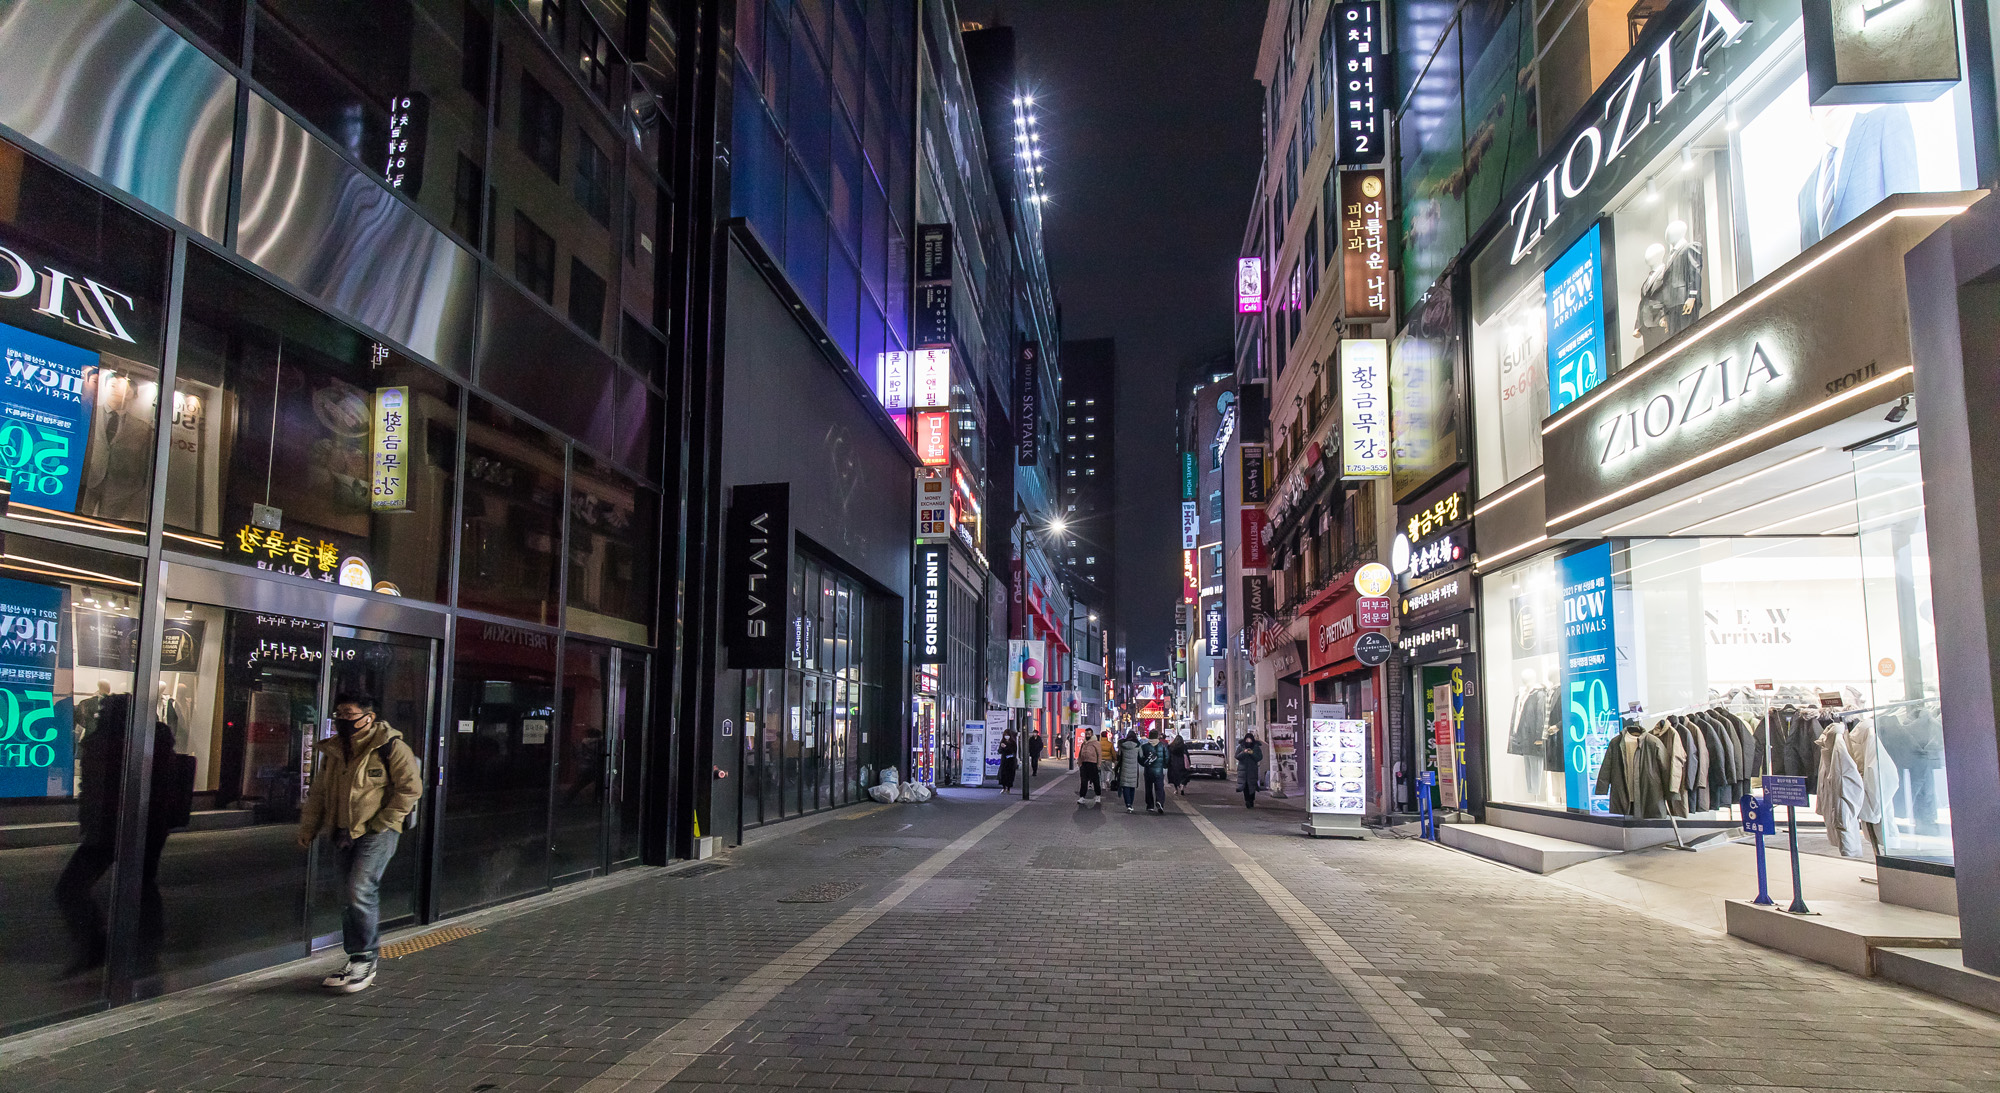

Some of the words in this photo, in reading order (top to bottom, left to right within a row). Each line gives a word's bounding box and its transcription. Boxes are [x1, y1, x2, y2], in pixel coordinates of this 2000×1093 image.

[1347, 6, 1374, 133] 이철헤어커커
[1356, 135, 1368, 152] 2
[1510, 0, 1753, 265] ZIOZIA
[1347, 202, 1364, 252] 피부과
[1365, 201, 1384, 269] 아름다운
[1368, 276, 1385, 310] 나라
[1553, 267, 1593, 319] new
[1554, 290, 1593, 329] ARRIVALS
[1503, 336, 1532, 374] SUIT
[1825, 361, 1880, 397] SEOUL
[1352, 366, 1377, 459] 황금목장
[1600, 341, 1783, 466] ZIOZIA
[1023, 395, 1033, 459] SKYPARK
[1408, 492, 1460, 543] 황금목장
[926, 552, 938, 587] LINE
[1251, 578, 1262, 610] SAVOY
[1362, 601, 1389, 610] 피부과
[1563, 589, 1606, 624] new
[925, 589, 938, 656] FRIENDS
[1209, 613, 1219, 655] MEDIHEAL
[1362, 613, 1389, 623] 전문의
[1565, 618, 1607, 637] ARRIVALS
[1705, 627, 1791, 644] Arrivals
[1451, 666, 1463, 696] $
